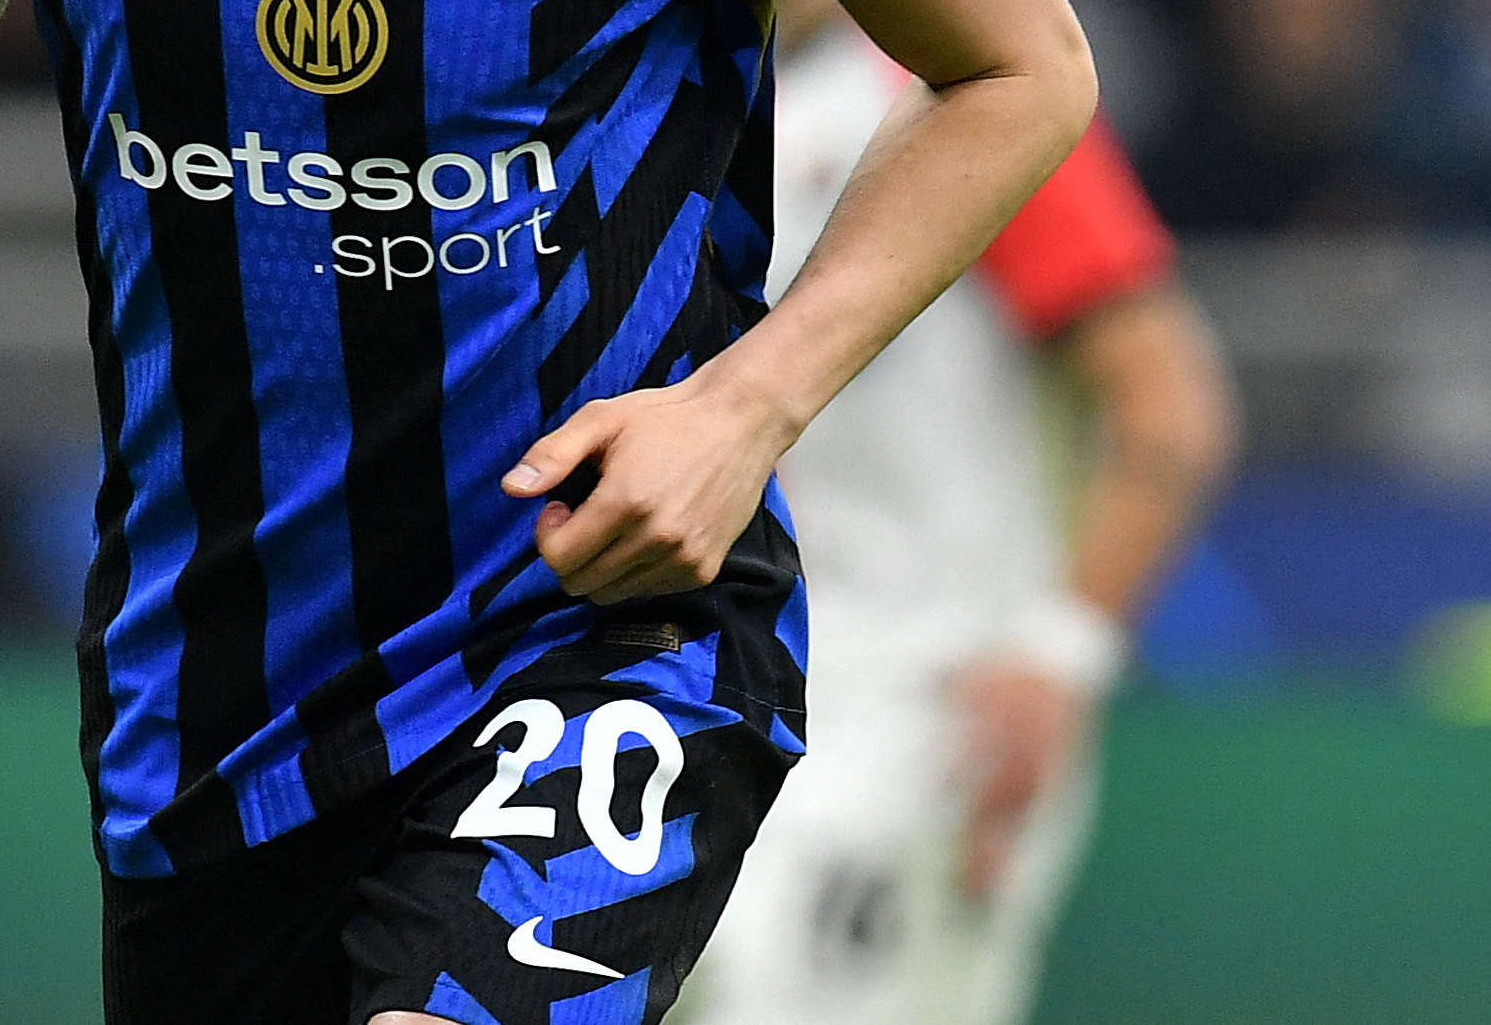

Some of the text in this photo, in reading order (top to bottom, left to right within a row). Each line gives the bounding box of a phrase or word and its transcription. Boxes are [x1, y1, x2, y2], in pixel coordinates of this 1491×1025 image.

[109, 113, 558, 211] betsson
[314, 207, 562, 291] .sport
[450, 698, 685, 876] 20
